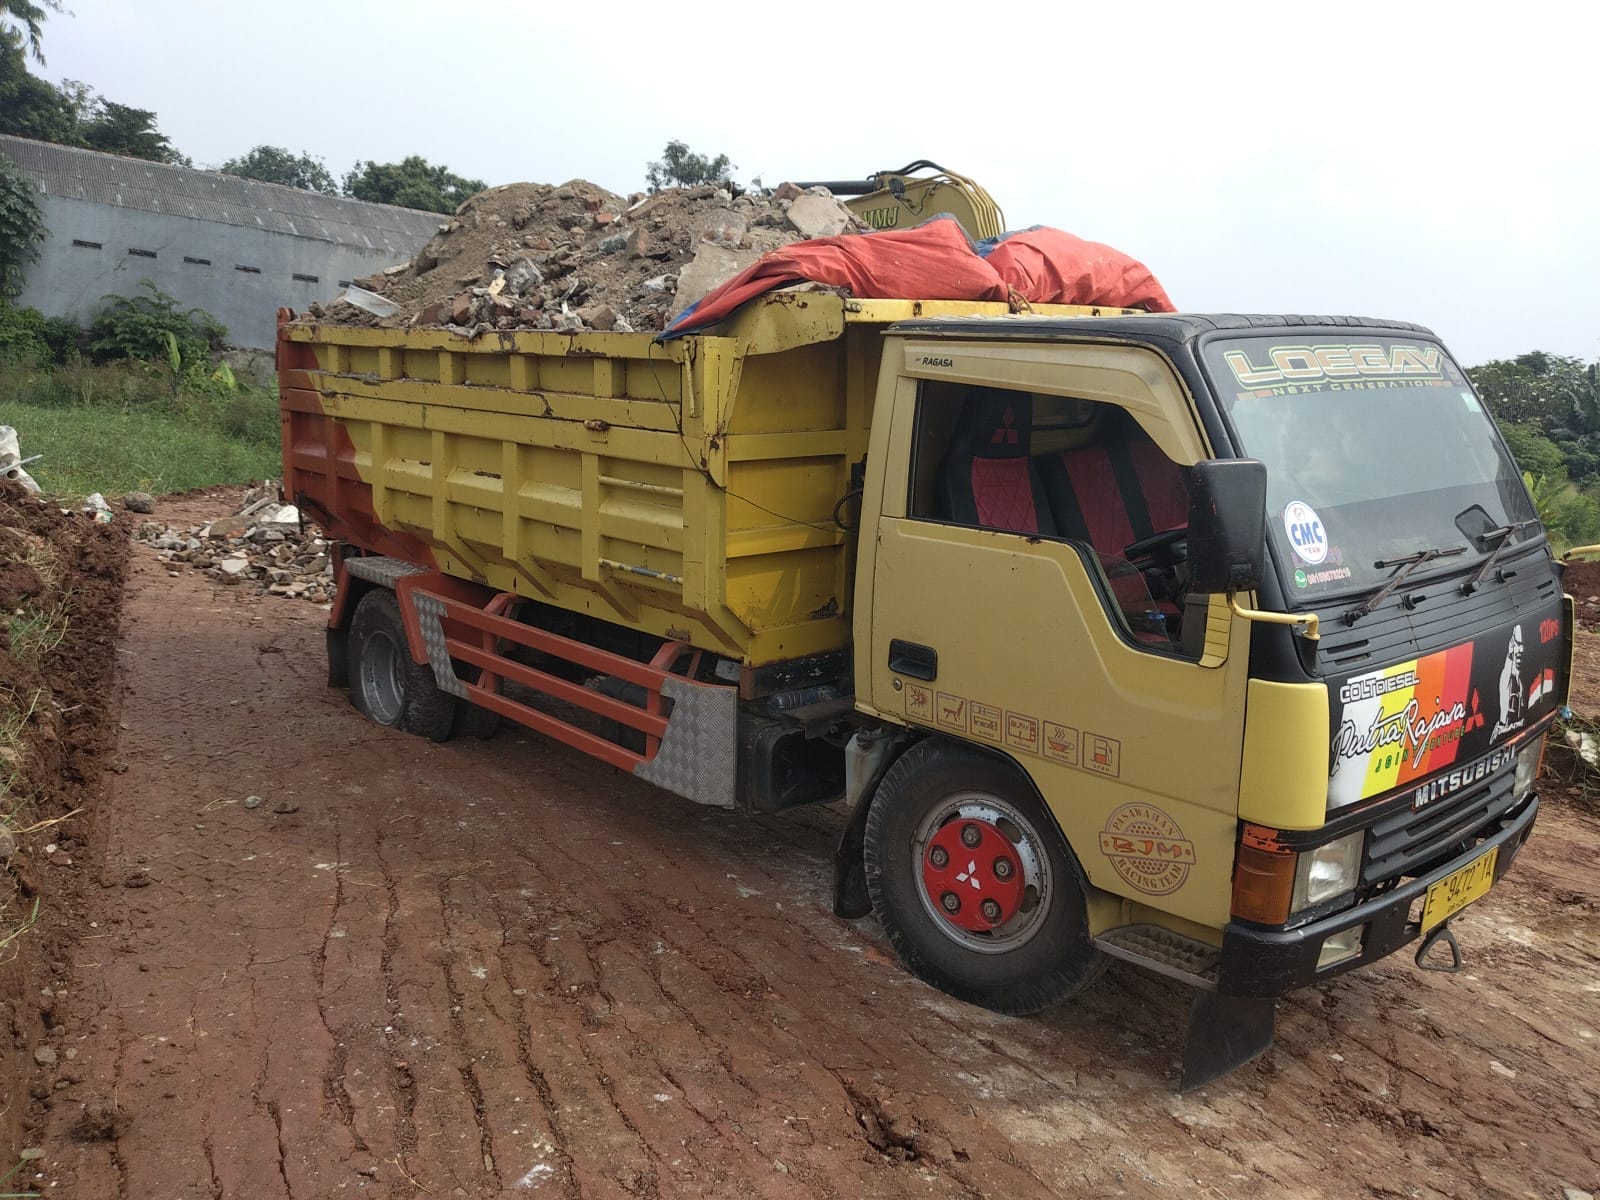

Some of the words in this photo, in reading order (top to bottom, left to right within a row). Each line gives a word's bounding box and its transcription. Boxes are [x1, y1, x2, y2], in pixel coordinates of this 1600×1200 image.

[922, 357, 953, 367] RAGASA
[1224, 344, 1443, 389] LOEGAY
[1273, 384, 1322, 396] NEXT
[1330, 380, 1433, 391] GENERATION
[1290, 521, 1323, 546] CMC
[1414, 744, 1516, 808] MITSUBISHI
[1159, 864, 1182, 887] TEAM
[1427, 887, 1438, 915] E
